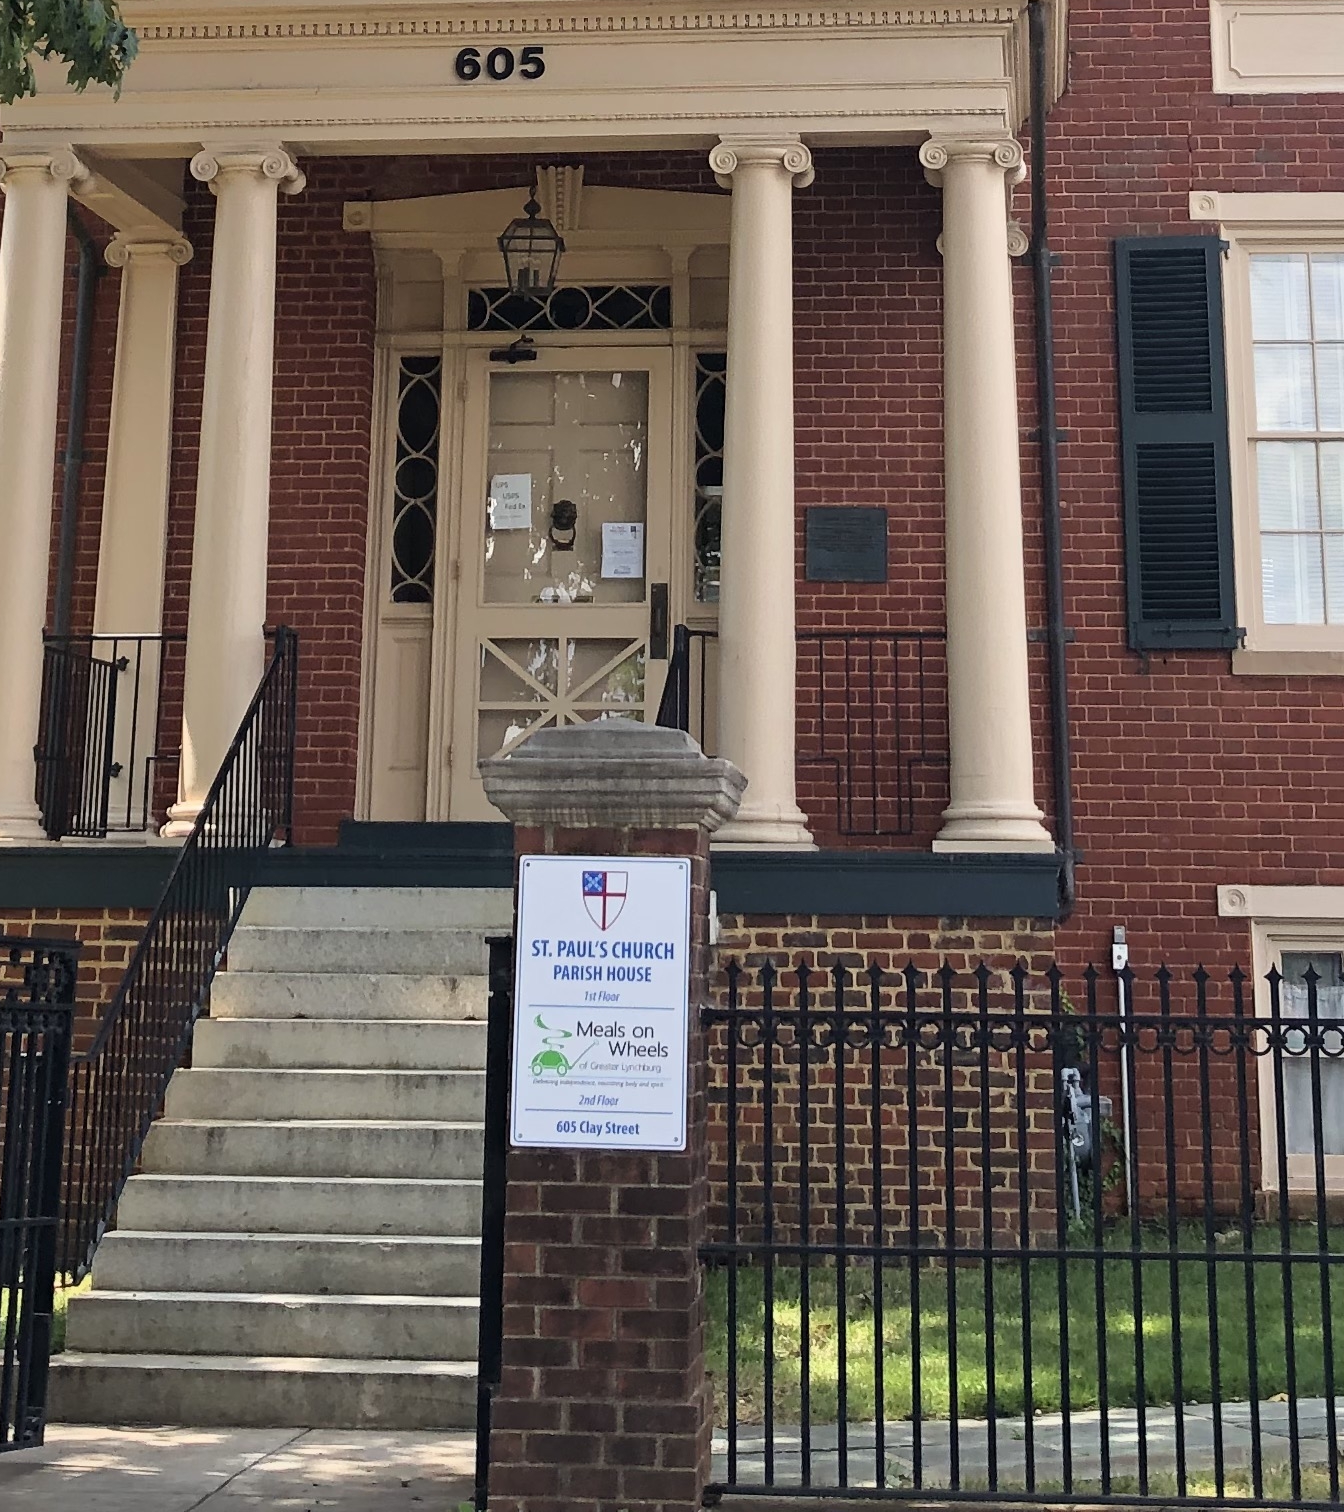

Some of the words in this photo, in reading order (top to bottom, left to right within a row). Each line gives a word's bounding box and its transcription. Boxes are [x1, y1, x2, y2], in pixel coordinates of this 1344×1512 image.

[455, 46, 546, 81] 605
[531, 939, 553, 957] ST.
[557, 940, 608, 958] PAUL'S
[611, 941, 675, 960] CHURCH
[553, 964, 603, 981] PARISH
[606, 966, 652, 982] HOUSE
[584, 990, 597, 1001] 1st
[598, 990, 621, 1002] Floor
[576, 1020, 626, 1038] Meals
[632, 1025, 654, 1038] on
[608, 1040, 669, 1058] Wheels
[578, 1061, 588, 1069] of
[621, 1062, 662, 1074] Lynchburg
[578, 1094, 596, 1106] 2nd
[596, 1095, 619, 1107] Floor
[556, 1120, 577, 1133] 605
[579, 1120, 603, 1137] Clay
[605, 1121, 640, 1135] Street
